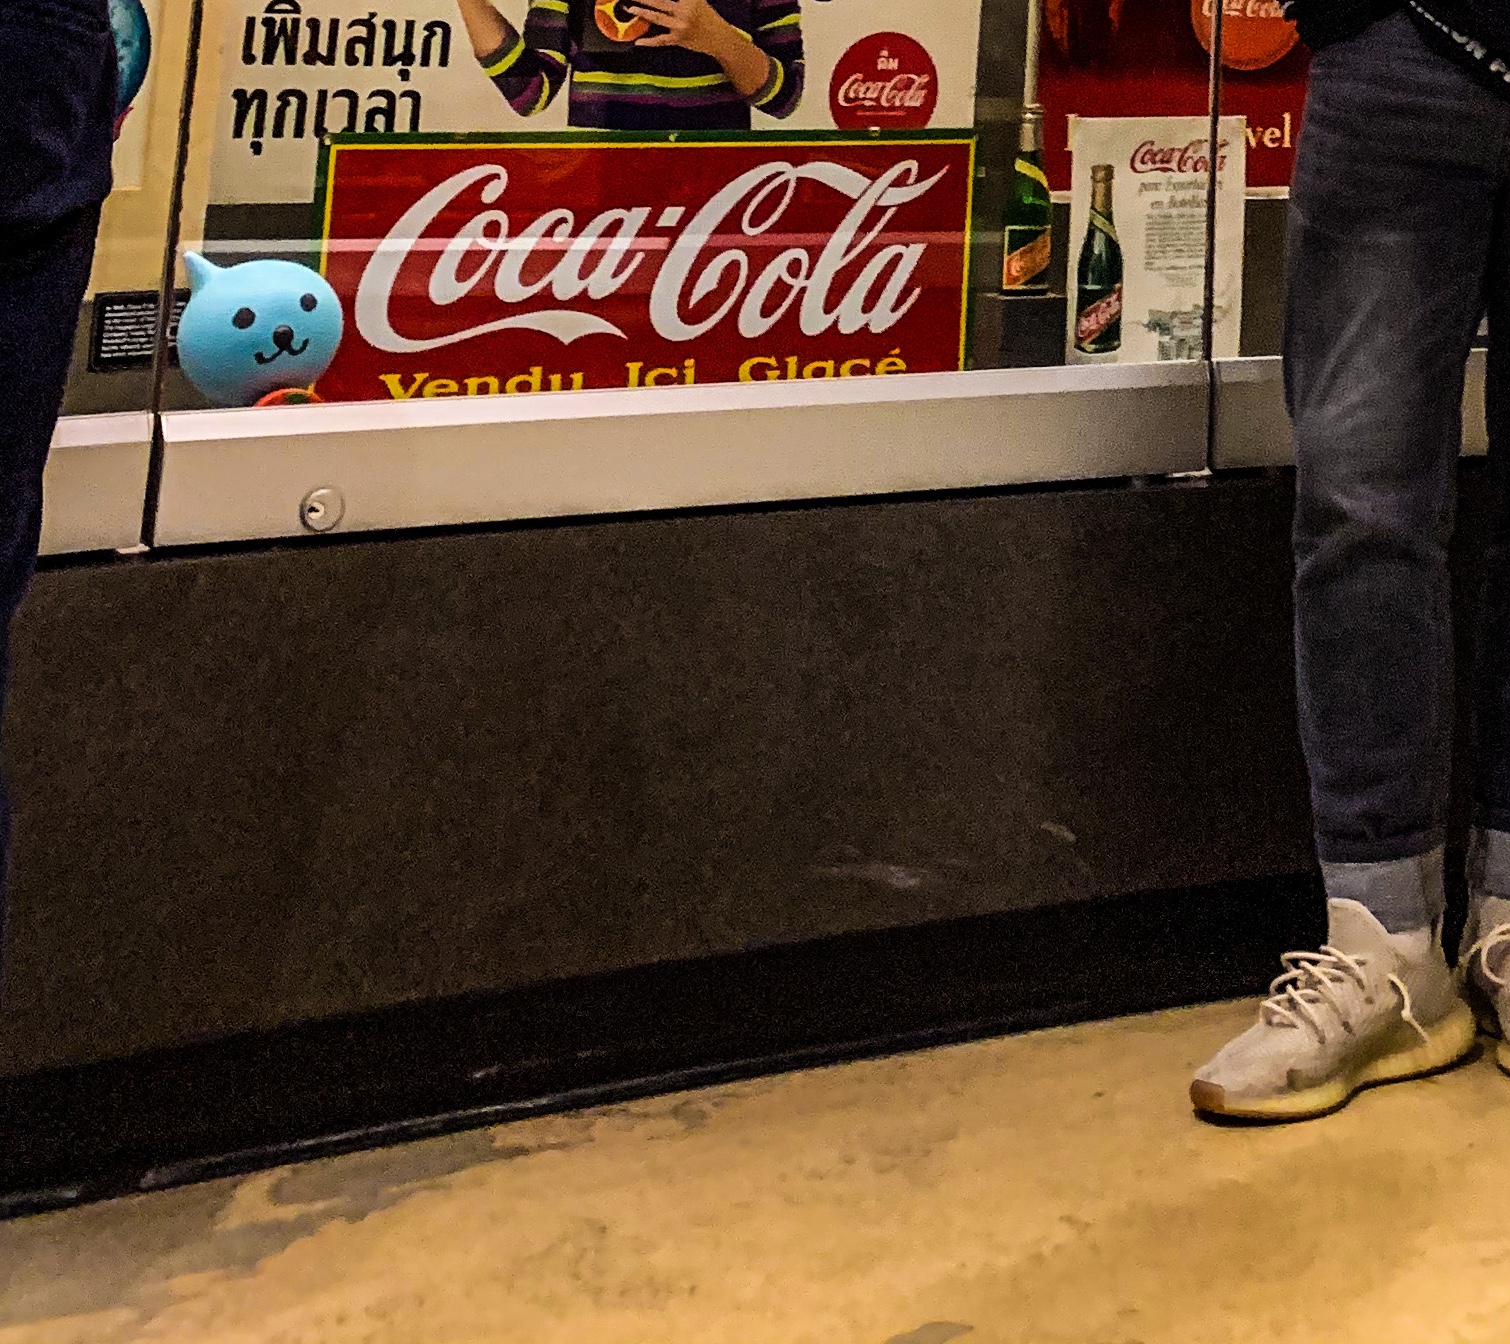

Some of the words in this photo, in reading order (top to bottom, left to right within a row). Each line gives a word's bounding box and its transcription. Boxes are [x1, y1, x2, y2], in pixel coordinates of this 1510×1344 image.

[837, 72, 930, 108] Coca-Cola
[354, 158, 949, 354] Coca-Cola
[380, 365, 585, 400] Vendu
[737, 347, 908, 383] Glacé
